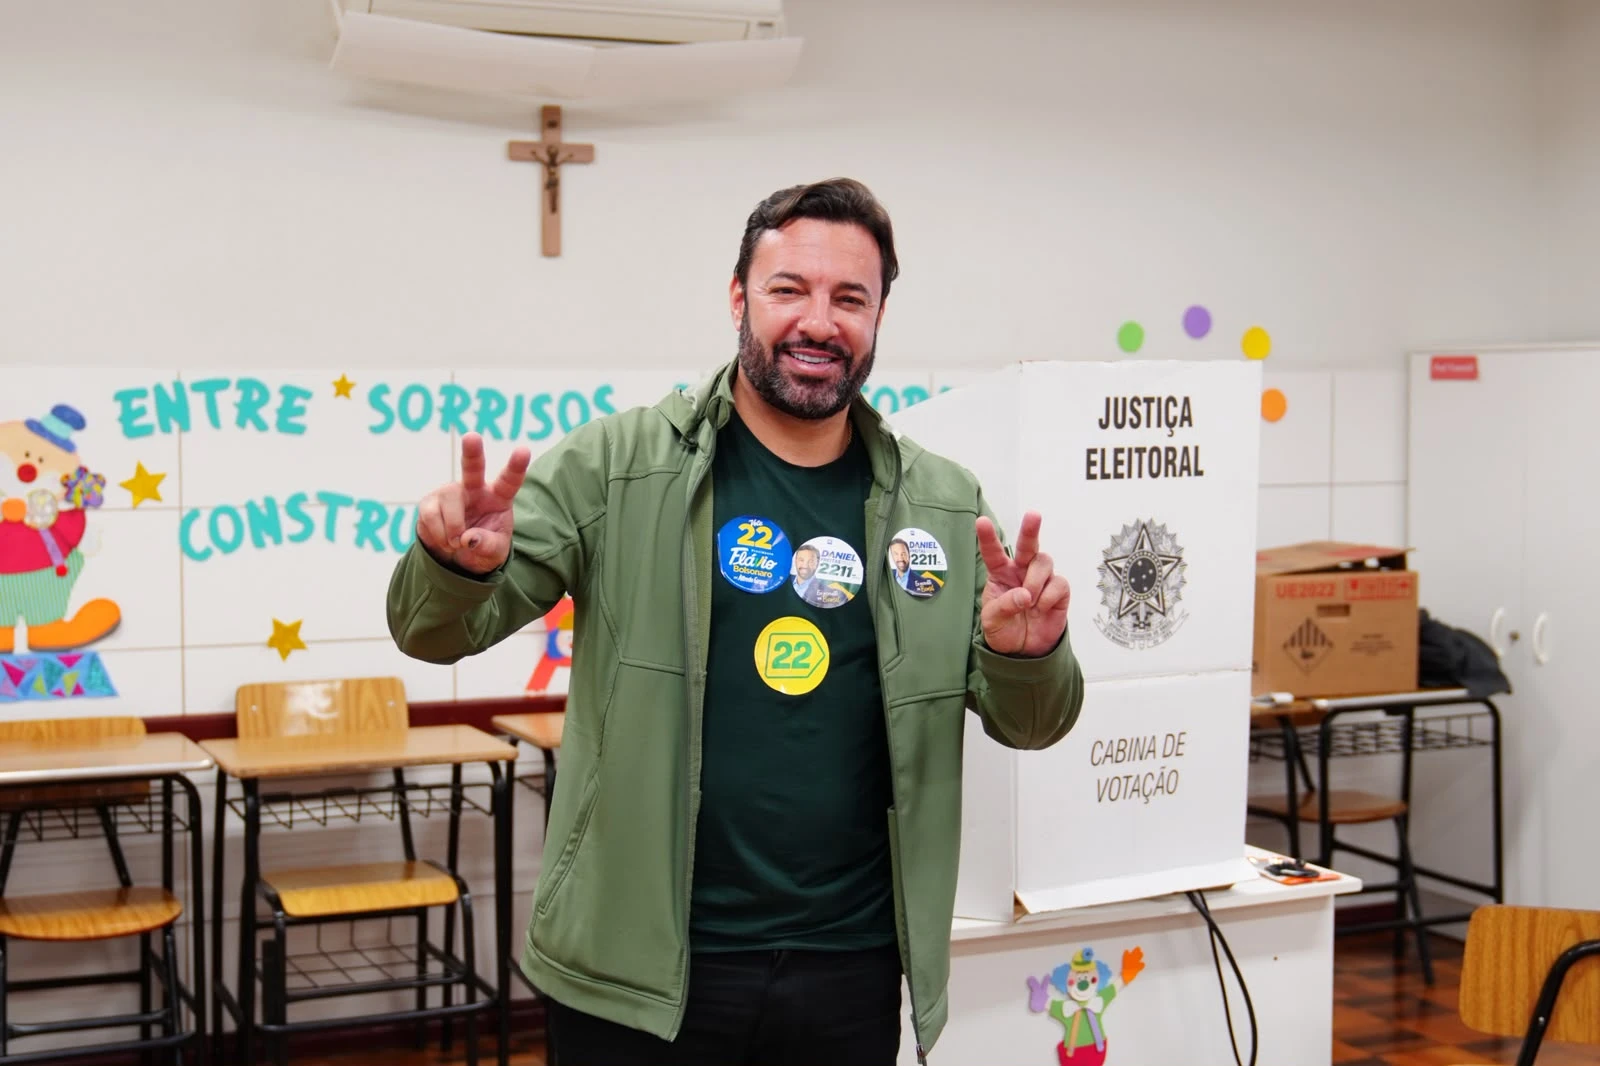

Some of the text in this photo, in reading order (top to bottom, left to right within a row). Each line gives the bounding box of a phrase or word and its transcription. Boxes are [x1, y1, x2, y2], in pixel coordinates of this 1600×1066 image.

[113, 377, 313, 439] ENTRE
[1098, 395, 1193, 438] JUSTIÇA
[1085, 445, 1205, 480] ELEITORAL
[737, 523, 773, 550] 22
[909, 541, 938, 549] DANIEL
[821, 550, 857, 562] DANIEL
[910, 553, 937, 566] 2211
[732, 565, 773, 578] Bolsonaro
[817, 562, 854, 578] 2211
[1275, 582, 1336, 599] UE2022
[772, 641, 812, 669] 22
[1090, 731, 1187, 766] CABINA DE
[1097, 766, 1179, 804] VOTAÇÃO
